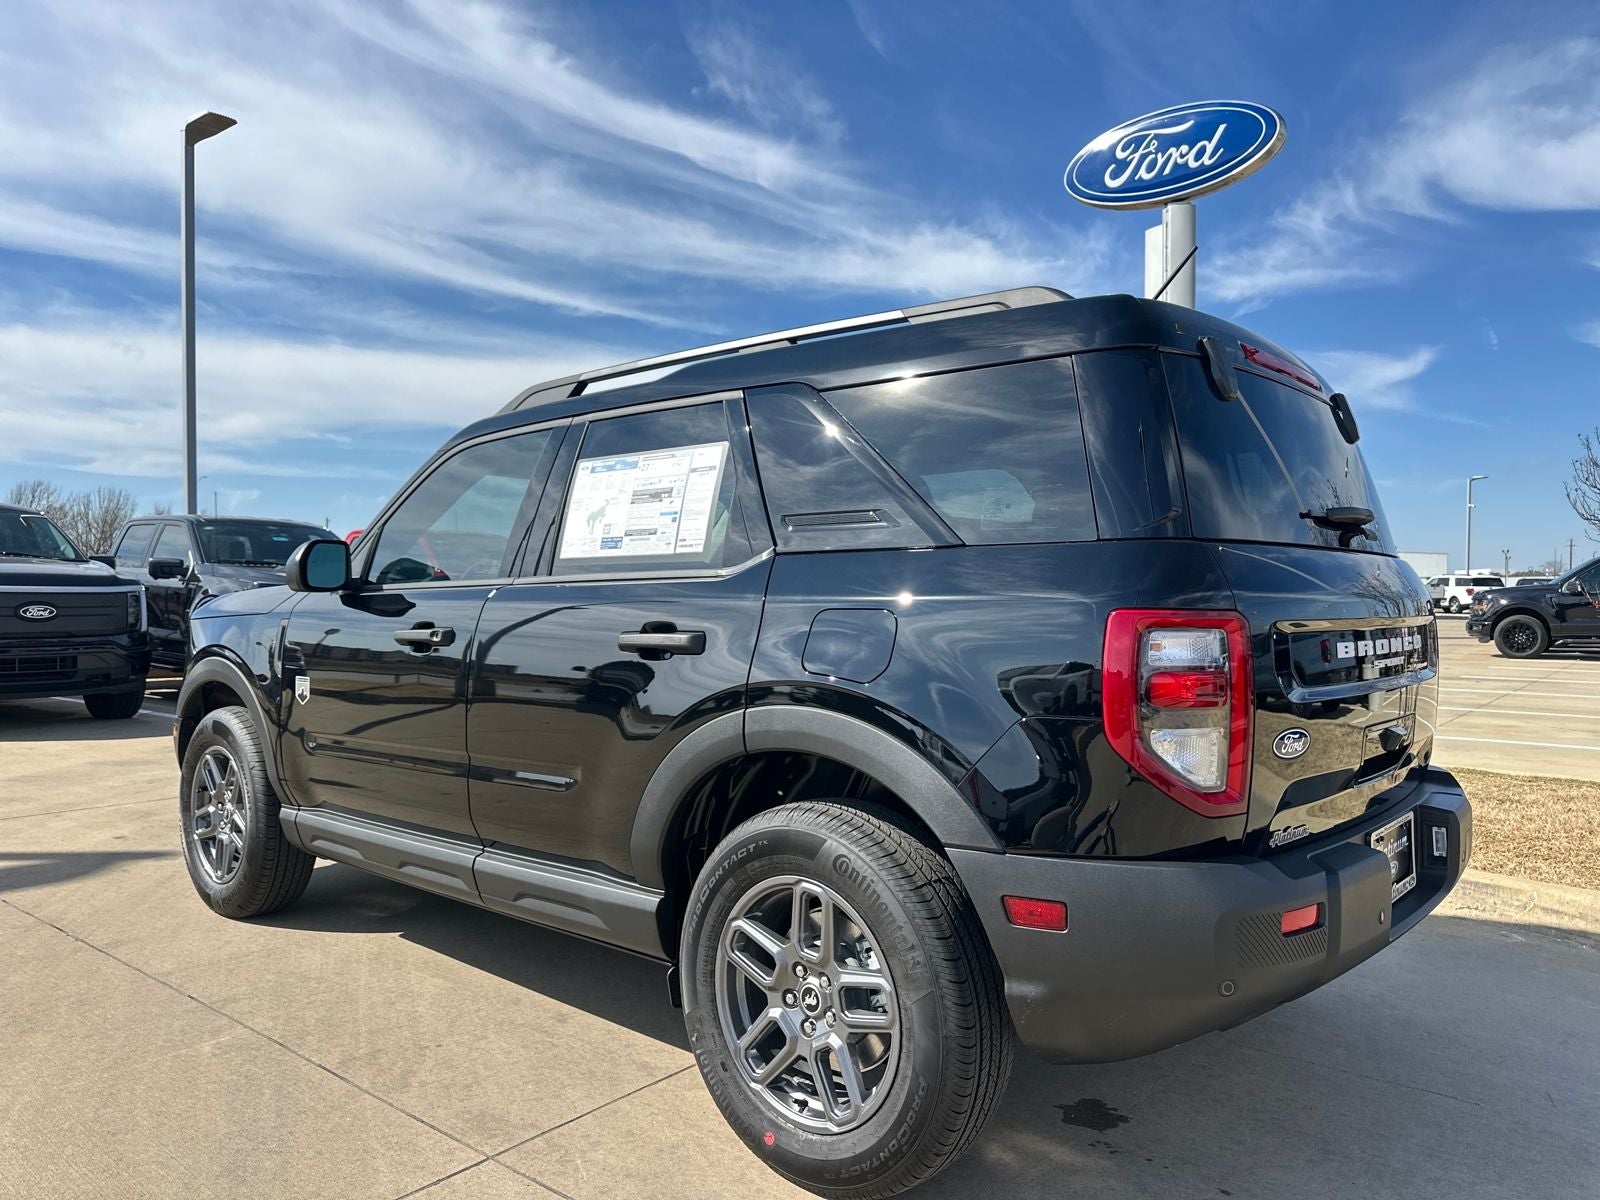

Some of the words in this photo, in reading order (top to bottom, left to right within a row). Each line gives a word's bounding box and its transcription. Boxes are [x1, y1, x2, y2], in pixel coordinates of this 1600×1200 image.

[1104, 120, 1227, 188] Ford
[27, 607, 50, 616] Ford
[1337, 635, 1422, 658] BRONCO
[1281, 734, 1305, 753] Ford
[1269, 826, 1309, 848] Platinum
[832, 853, 915, 958] Continental
